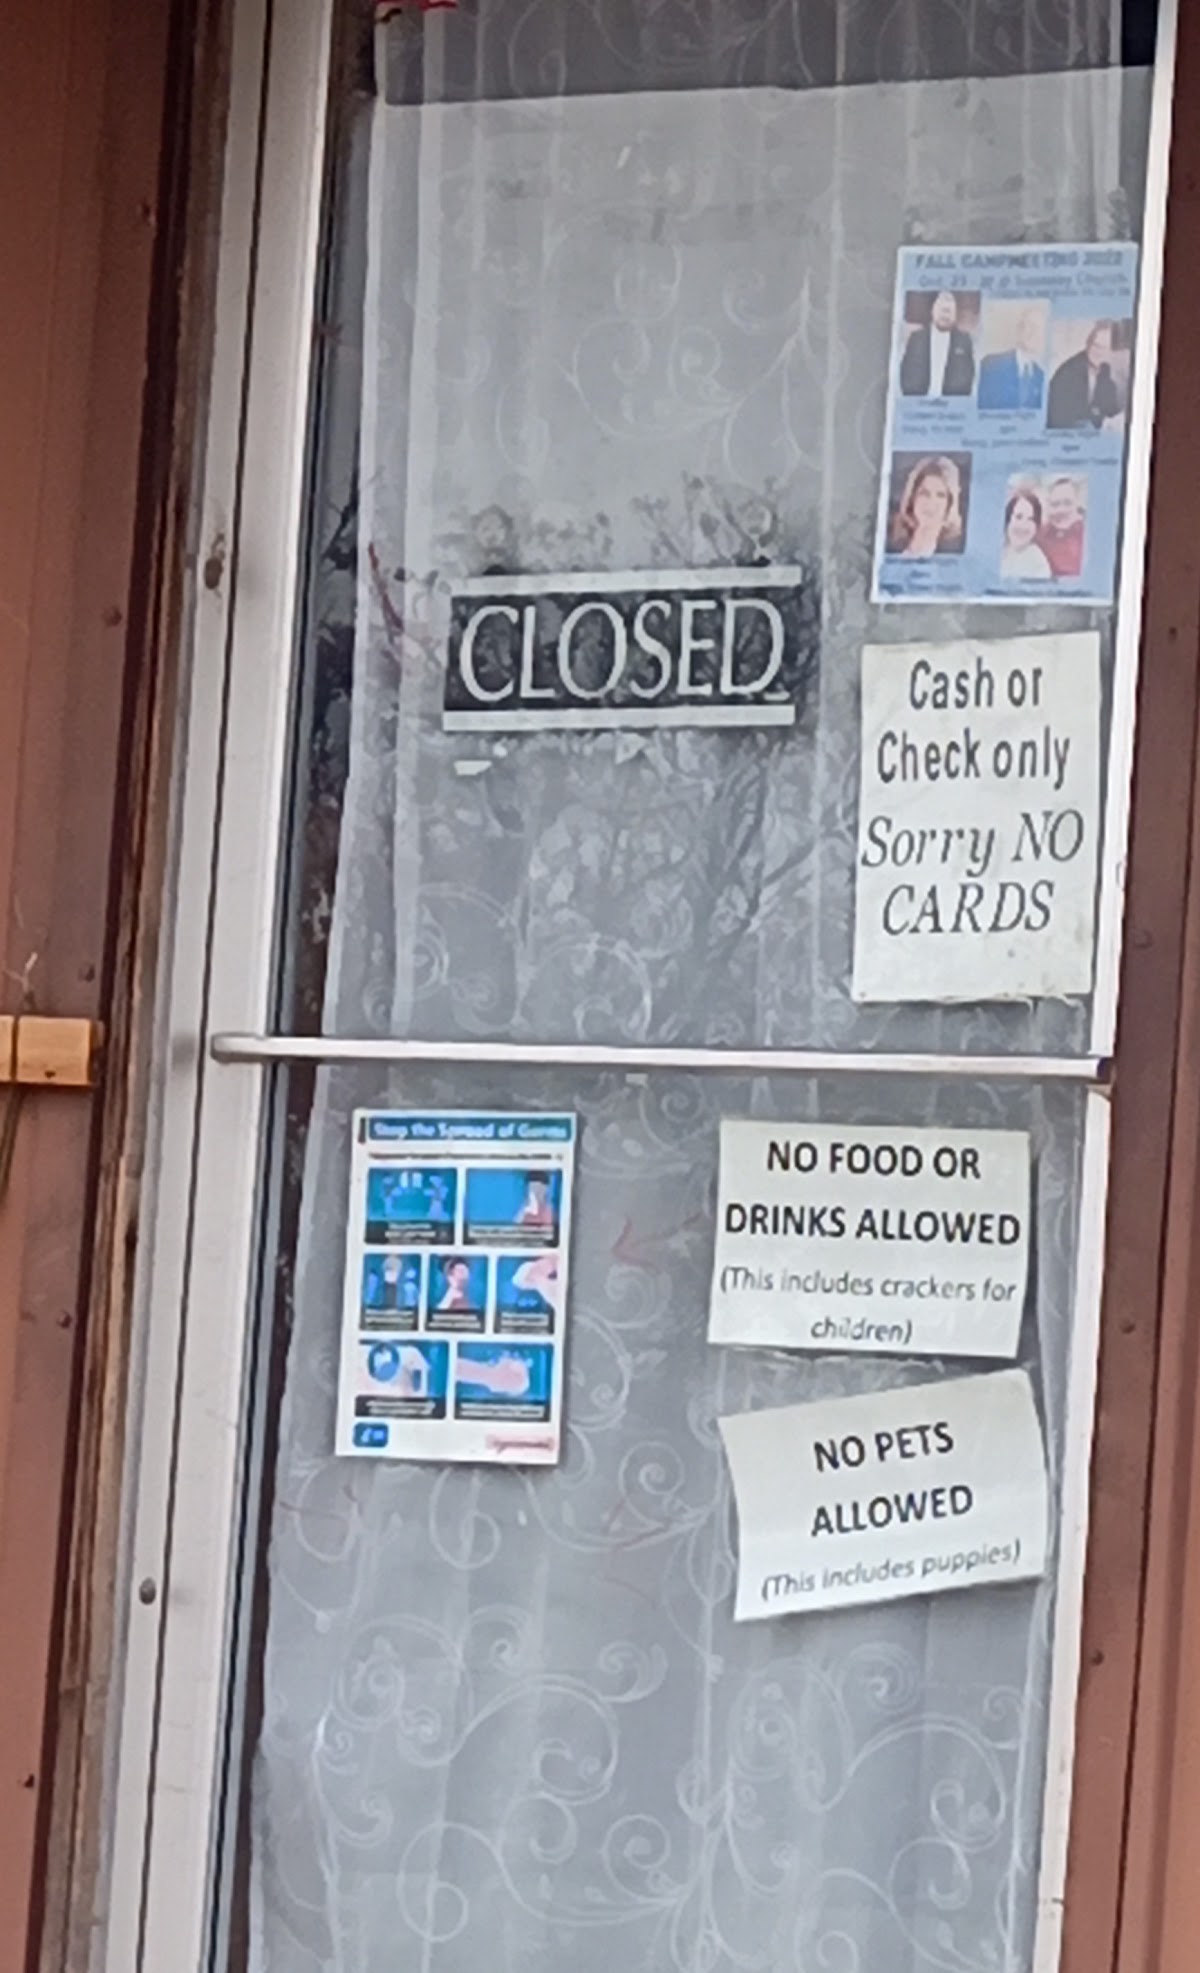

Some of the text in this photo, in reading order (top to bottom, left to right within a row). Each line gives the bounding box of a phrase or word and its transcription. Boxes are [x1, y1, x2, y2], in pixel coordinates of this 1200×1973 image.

[459, 598, 785, 702] CLOSED
[910, 656, 1042, 710] Cash or
[877, 725, 1070, 790] Check only
[861, 808, 1084, 878] Sorry NO
[882, 879, 1055, 936] CARDS
[767, 1141, 981, 1179] NO FOOD OR
[725, 1203, 1021, 1245] DRINKS ALLOWED
[720, 1266, 1017, 1302] (This includes crackers for
[811, 1316, 913, 1344] children)
[813, 1422, 954, 1472] NO PETS
[811, 1485, 973, 1537] ALLOWED
[762, 1539, 1021, 1602] (This includes puppies)
